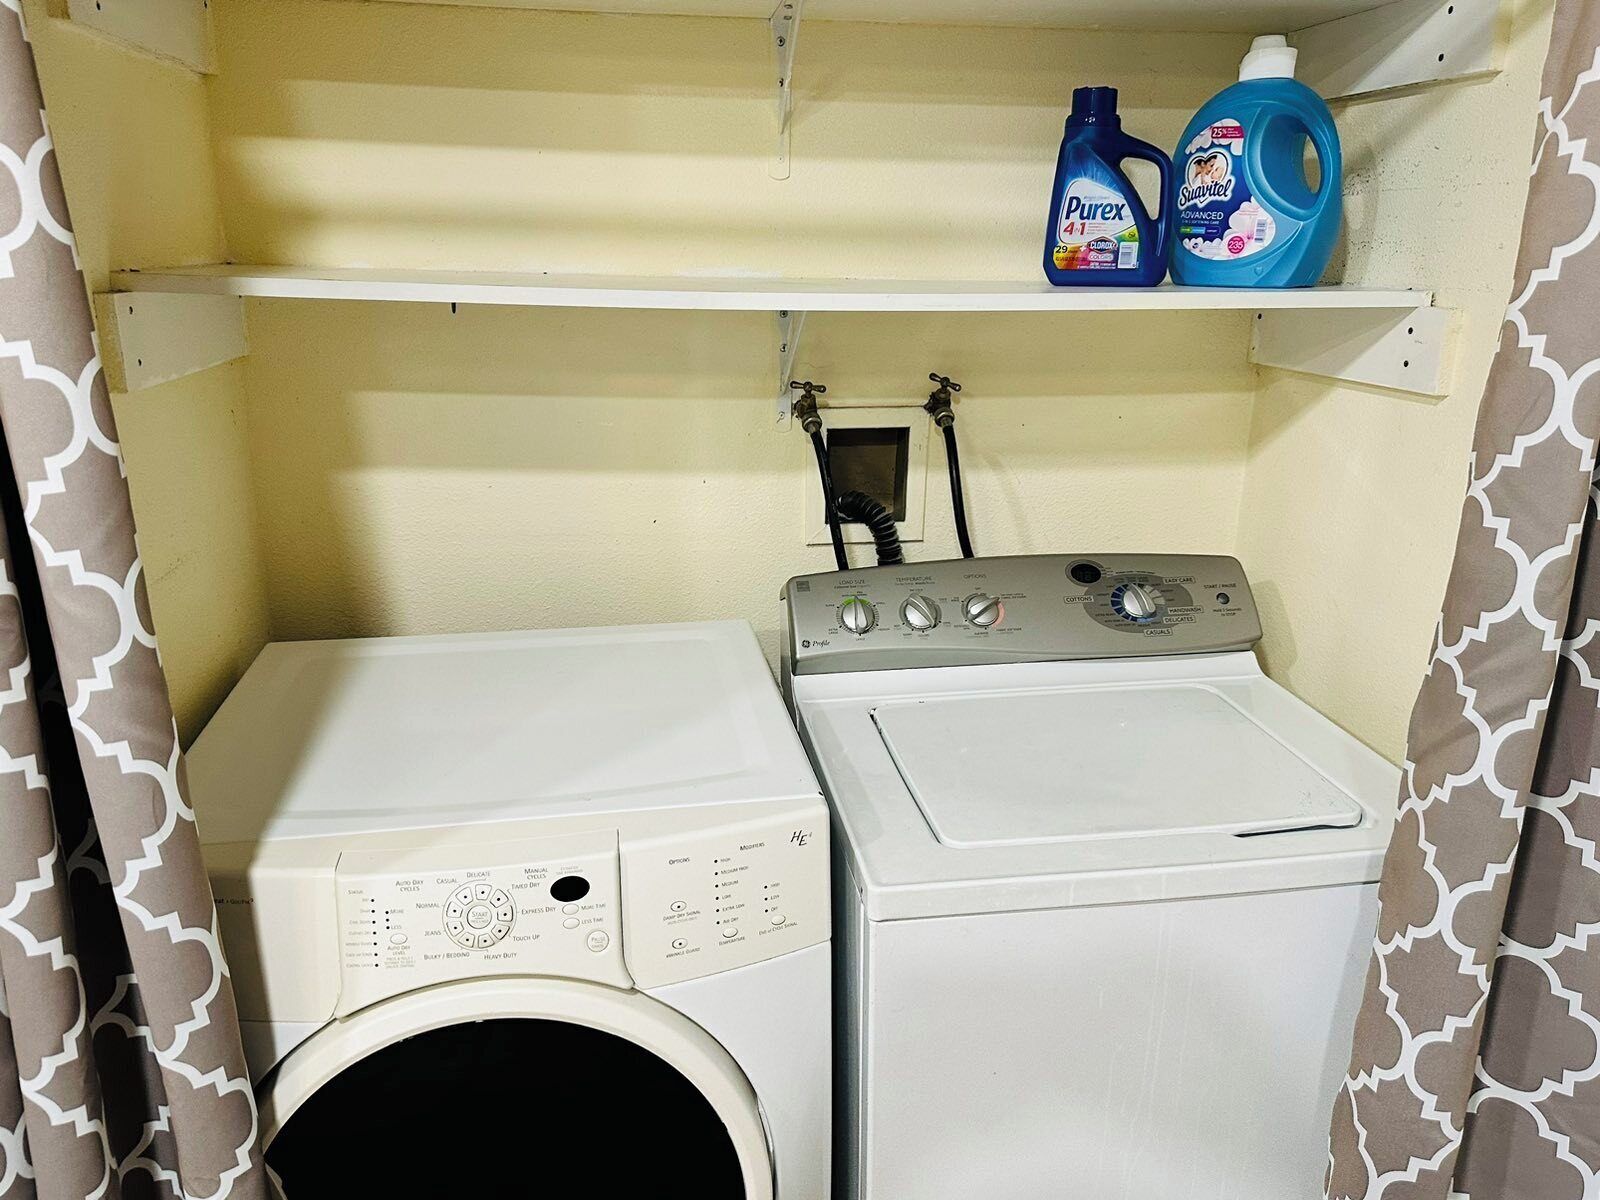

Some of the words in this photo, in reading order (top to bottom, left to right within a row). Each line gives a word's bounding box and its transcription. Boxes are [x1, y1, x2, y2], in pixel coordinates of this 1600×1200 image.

[1180, 178, 1232, 206] Suavitel
[1065, 196, 1126, 220] Purex
[1180, 211, 1224, 220] ADVANCED
[1228, 241, 1243, 249] 235
